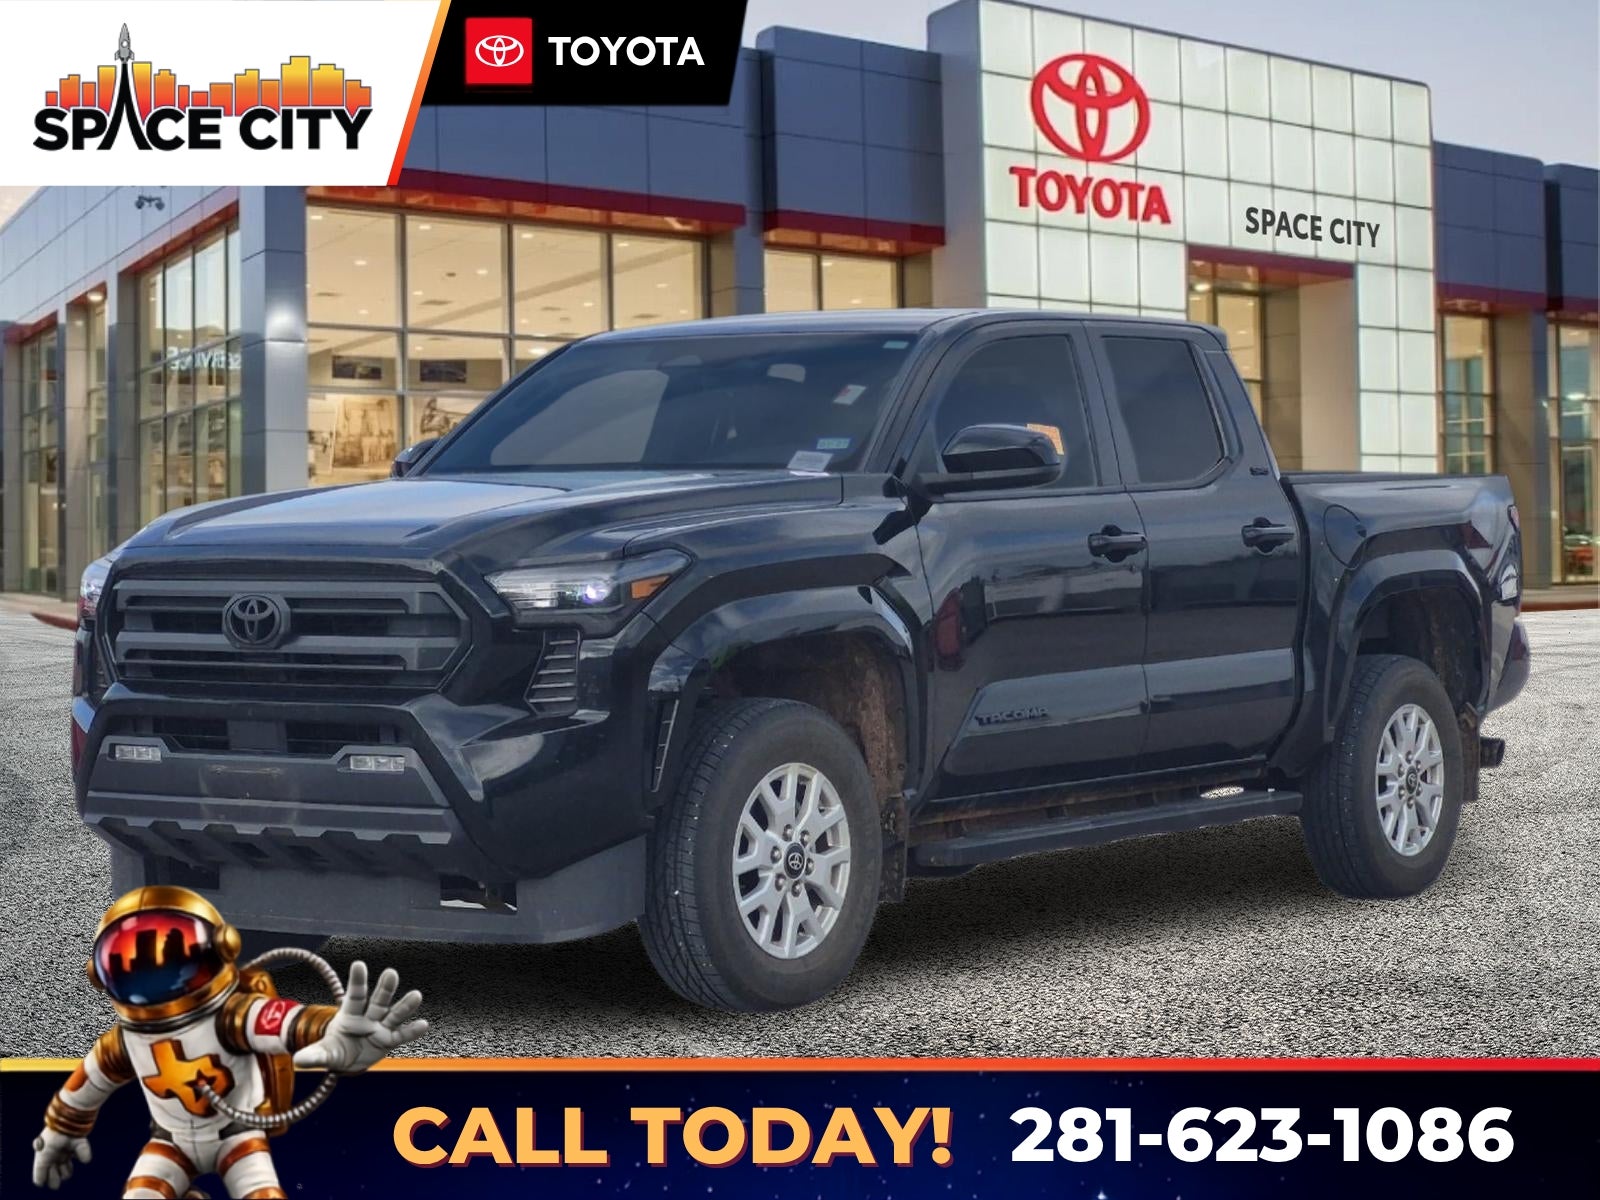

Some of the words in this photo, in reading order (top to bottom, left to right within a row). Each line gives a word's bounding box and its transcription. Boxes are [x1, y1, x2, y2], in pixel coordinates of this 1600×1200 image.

[1009, 166, 1171, 224] TOYOTA
[1245, 206, 1323, 242] SPACE
[1329, 217, 1381, 248] CITY
[975, 706, 1049, 727] TACOMA
